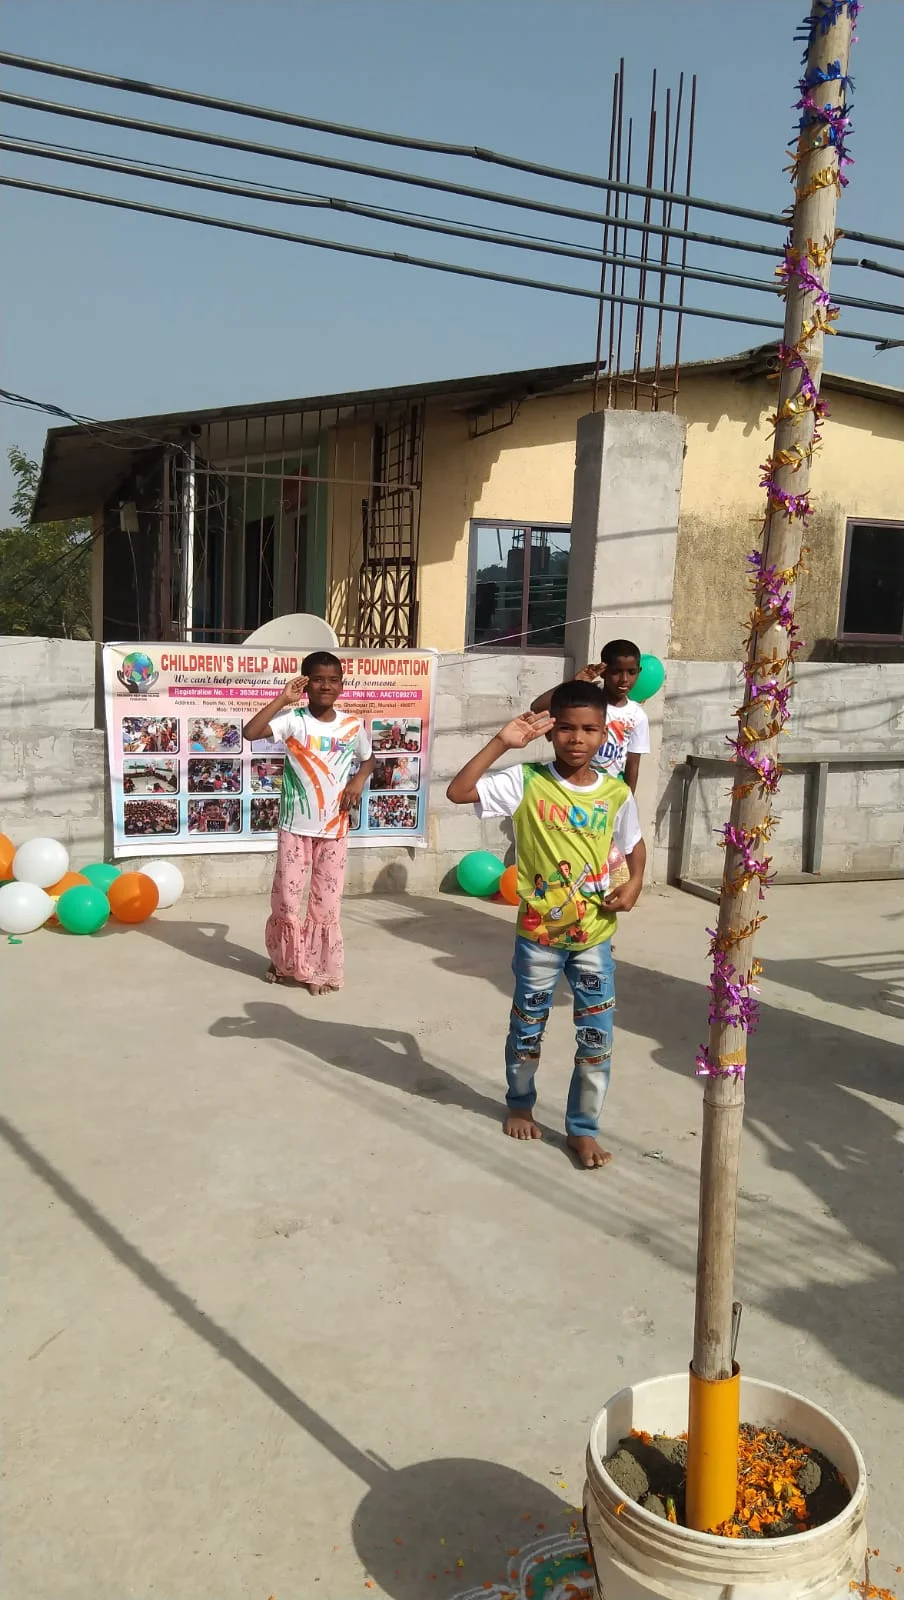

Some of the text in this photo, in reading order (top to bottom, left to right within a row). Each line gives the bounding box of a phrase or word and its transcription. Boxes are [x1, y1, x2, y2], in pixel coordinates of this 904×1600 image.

[160, 654, 234, 672] CHILDREN'S
[238, 656, 269, 673] HELP
[272, 657, 298, 673] AND
[357, 658, 430, 676] FOUNDATION
[174, 675, 188, 683] We
[190, 675, 211, 684] can't
[213, 675, 232, 686] help
[235, 677, 270, 687] everyone
[174, 688, 212, 696] Registration
[260, 689, 279, 697] Under
[537, 799, 609, 835] INDIA
